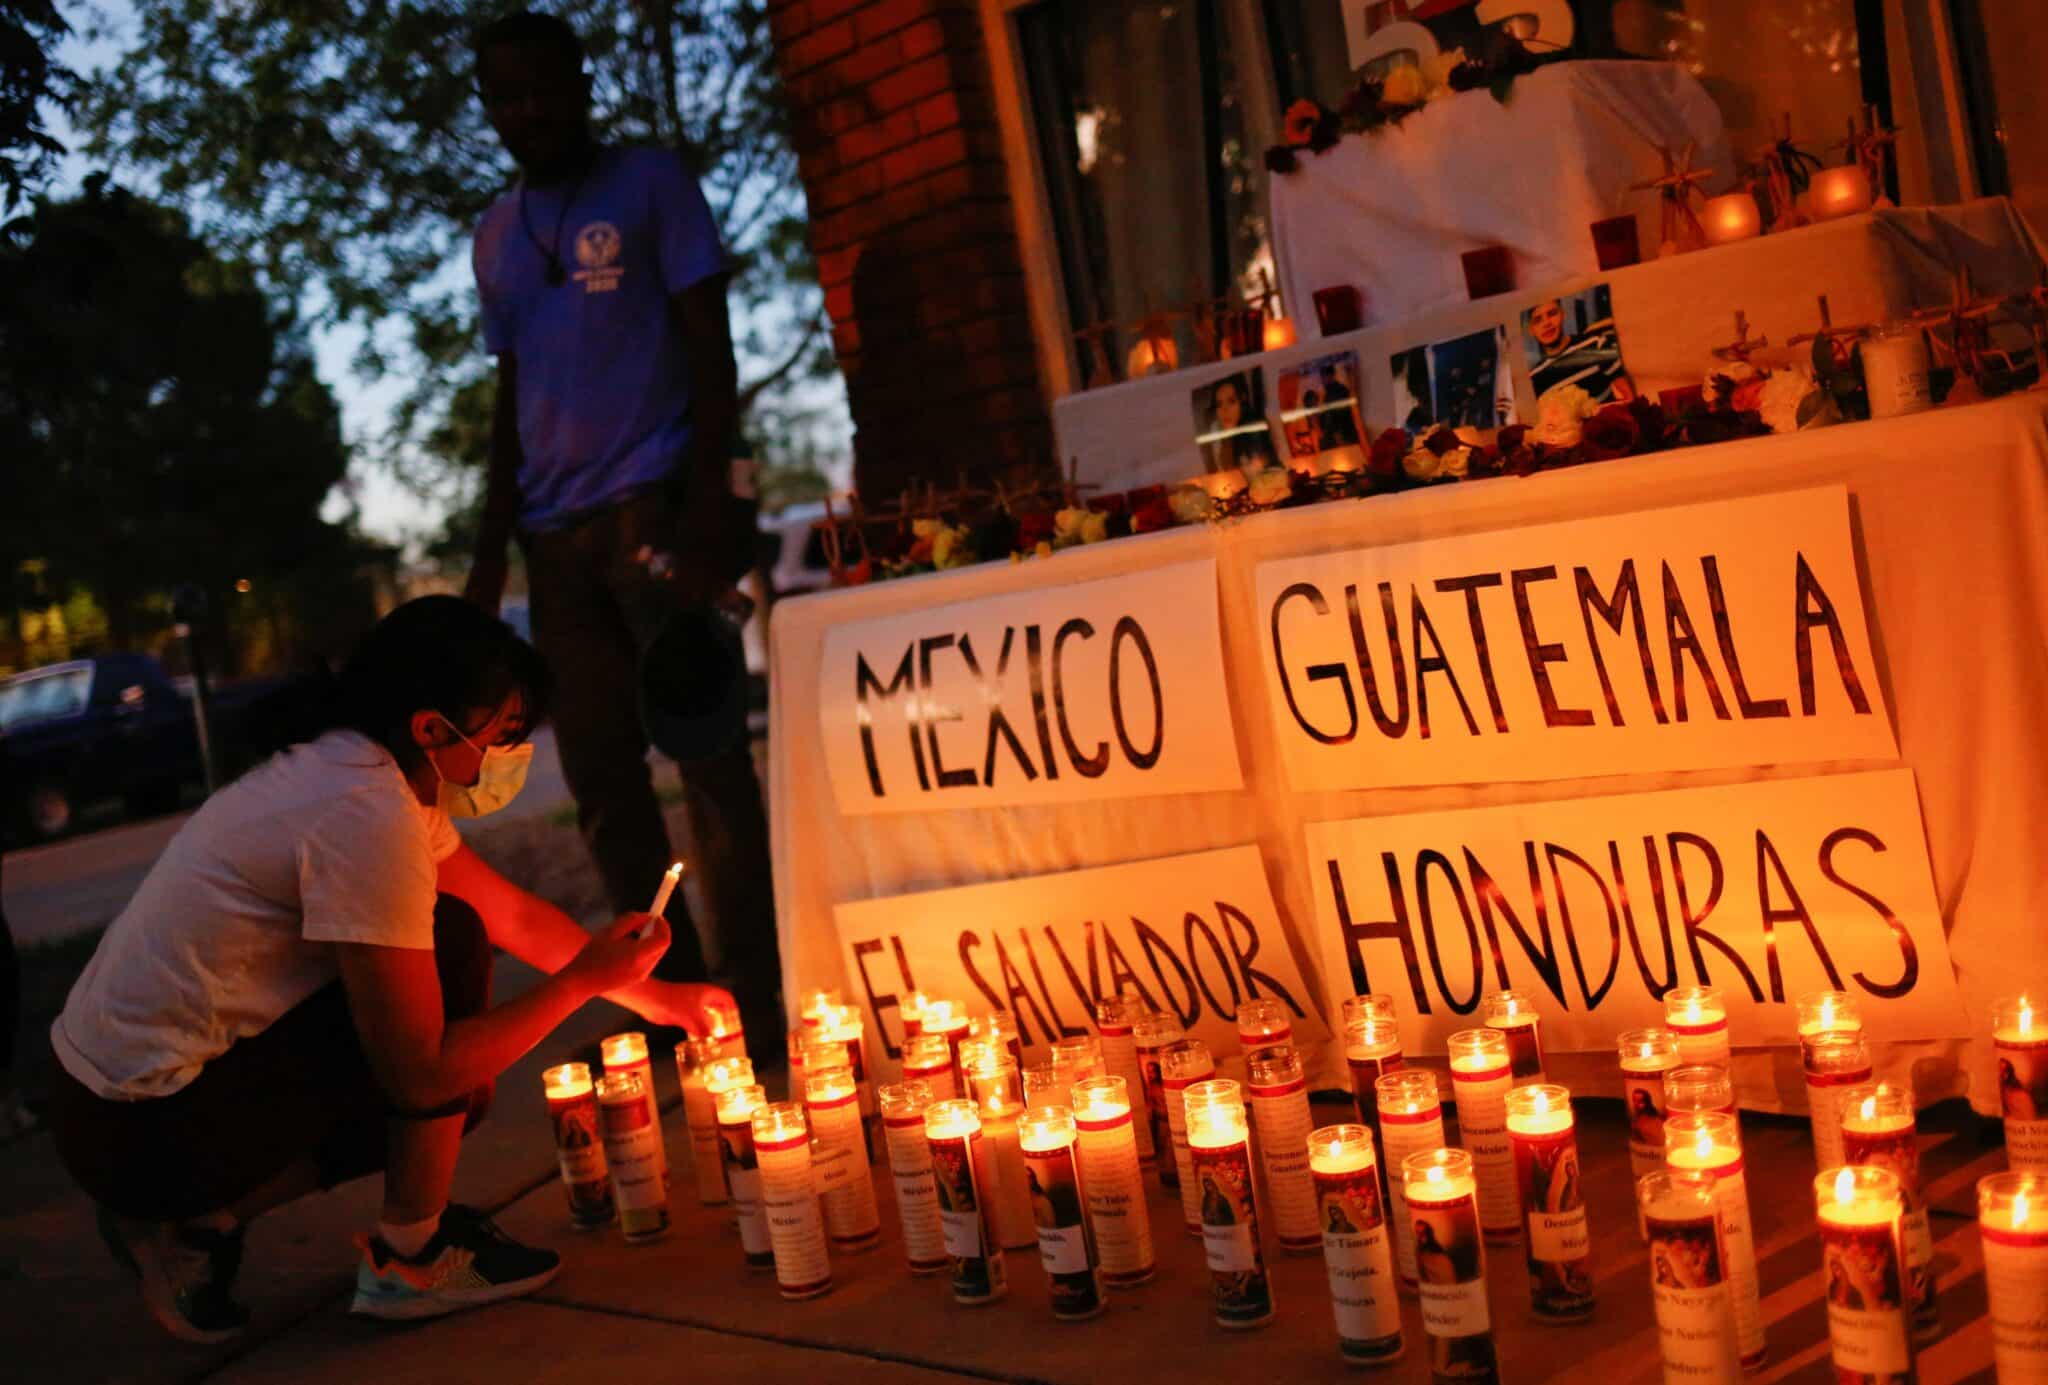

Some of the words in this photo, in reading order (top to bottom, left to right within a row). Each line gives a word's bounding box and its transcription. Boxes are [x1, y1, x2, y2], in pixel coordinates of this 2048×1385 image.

[856, 615, 1164, 797] MEXICO
[1271, 550, 1873, 746] GUATEMALA
[958, 900, 1306, 1048] SALVADOR
[1327, 827, 1919, 1016] HONDURAS
